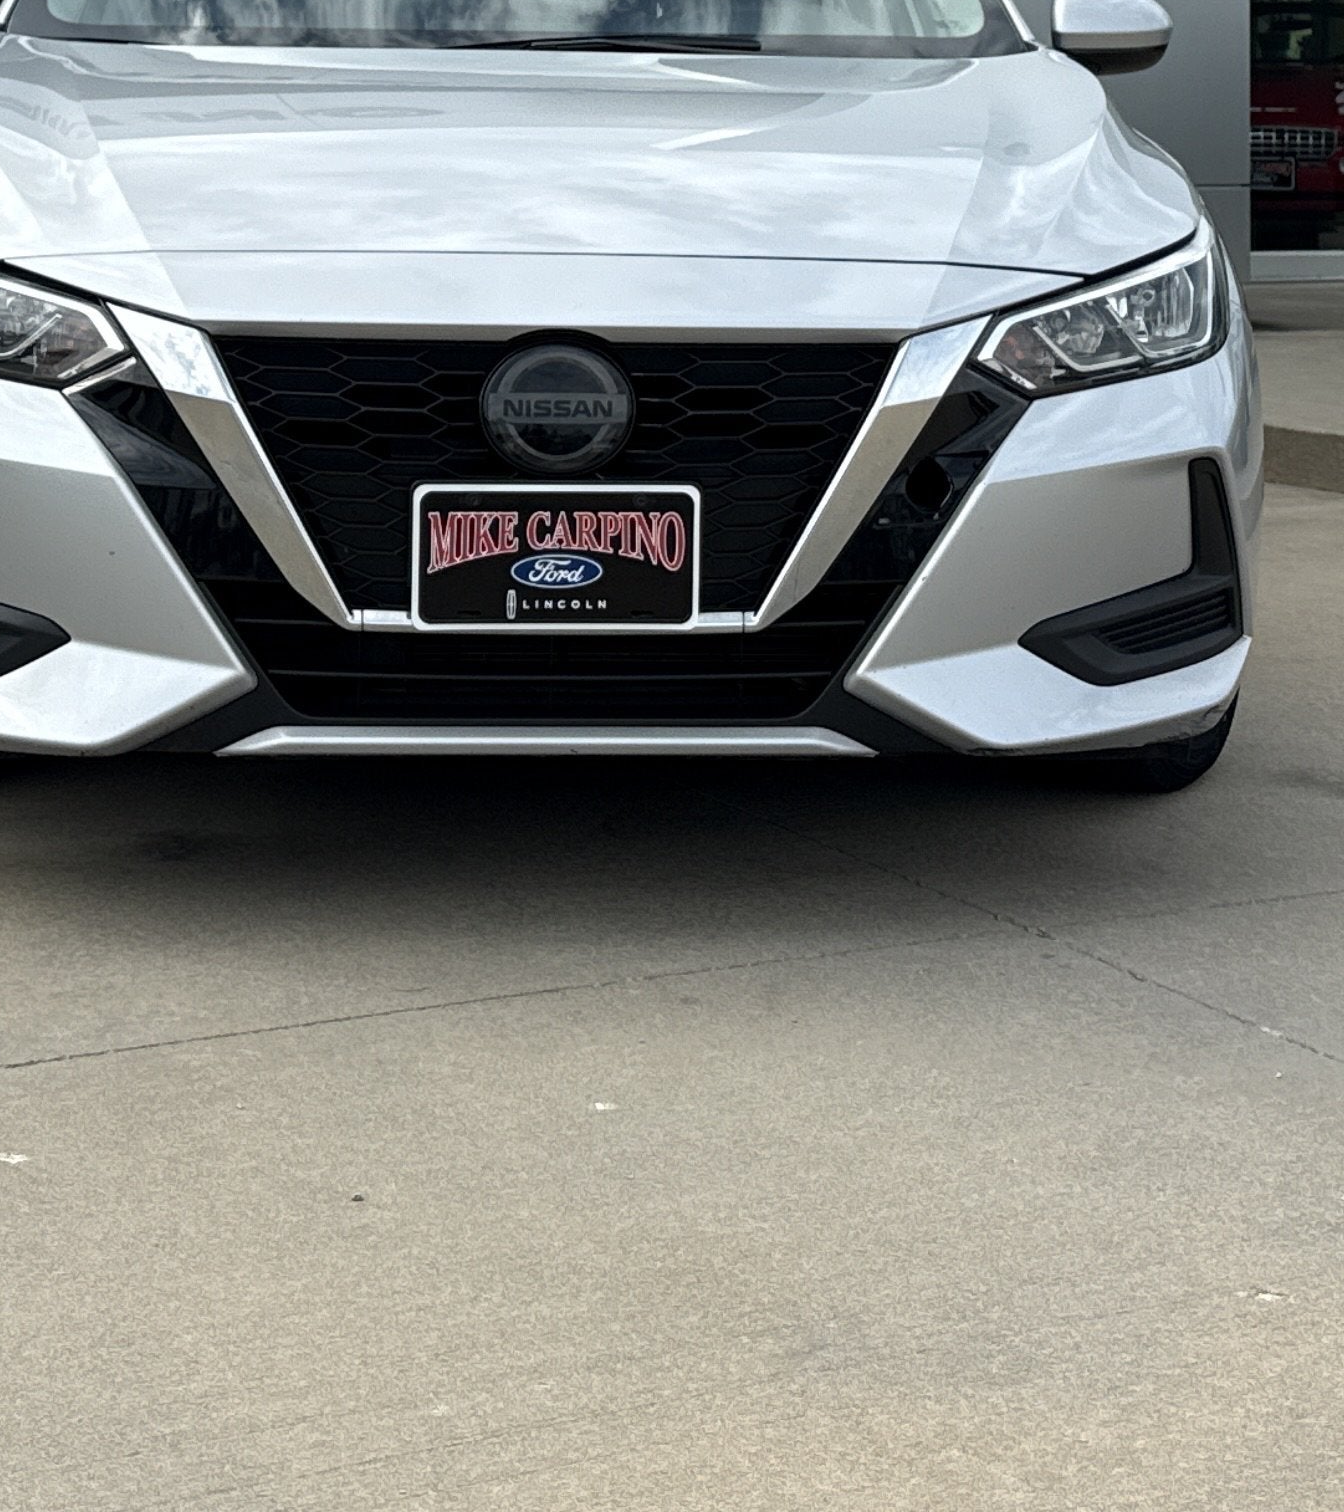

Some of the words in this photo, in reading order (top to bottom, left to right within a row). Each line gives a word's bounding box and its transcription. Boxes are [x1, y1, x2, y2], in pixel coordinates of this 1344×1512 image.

[502, 399, 613, 418] NISSAN
[427, 511, 519, 574] MIKE
[526, 511, 686, 571] CARPINO
[528, 558, 584, 583] Ford
[522, 599, 607, 610] LINCOLN
